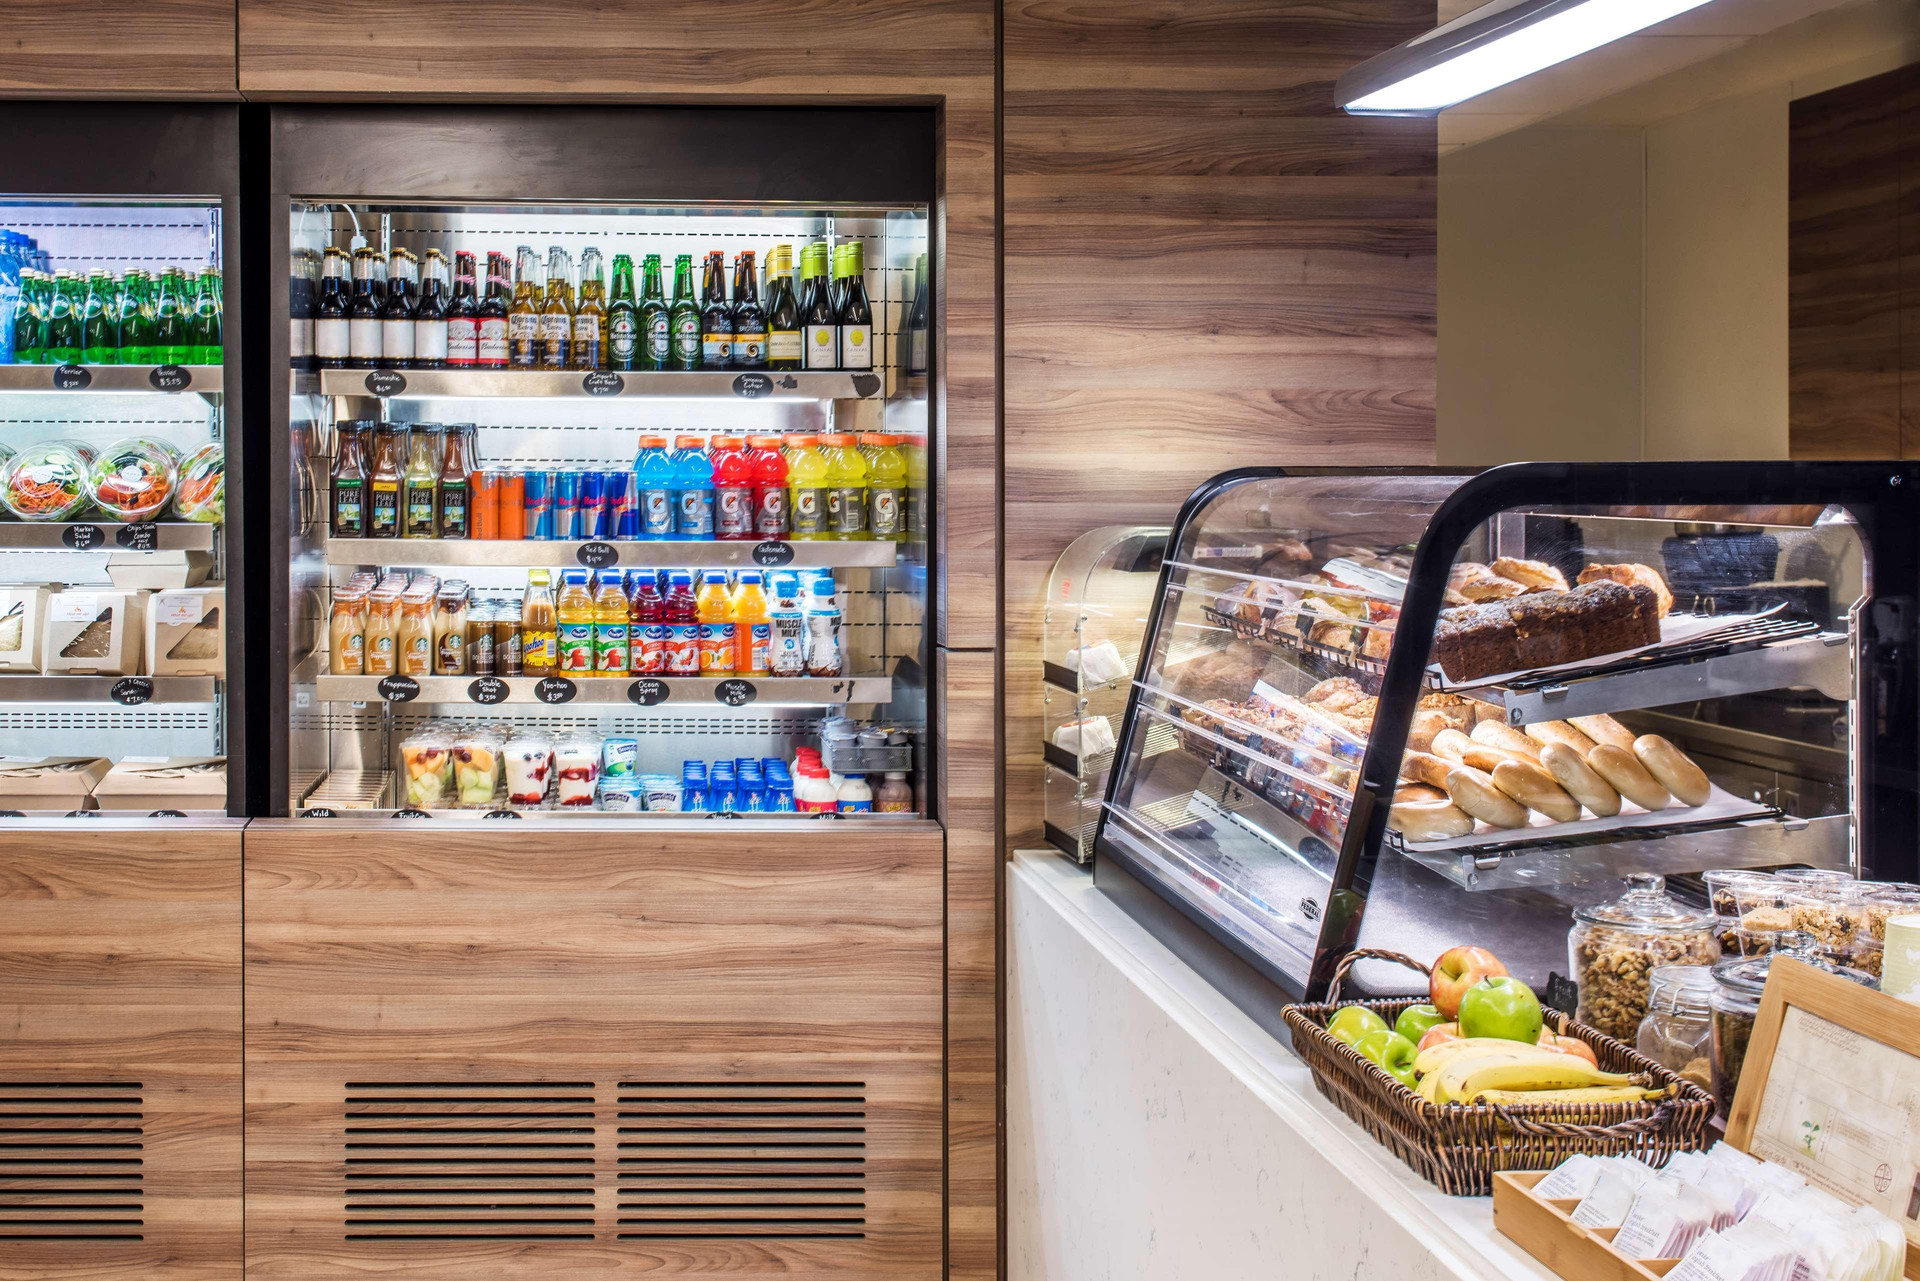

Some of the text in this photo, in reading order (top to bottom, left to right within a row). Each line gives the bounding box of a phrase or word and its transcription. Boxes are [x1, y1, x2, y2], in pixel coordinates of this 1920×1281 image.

[60, 366, 83, 376] Perrier
[584, 496, 599, 504] Red
[648, 492, 665, 514] G
[682, 492, 697, 514] G
[722, 492, 738, 513] G
[764, 492, 781, 513] G
[798, 492, 815, 513] G
[829, 491, 840, 513] G
[875, 492, 893, 514] G
[585, 545, 596, 553] Red
[758, 543, 787, 553] Gatorade
[782, 629, 797, 637] MILK
[543, 681, 568, 692] Yoo-hoo
[640, 687, 658, 695] Spray
[312, 809, 329, 817] Wild
[1300, 902, 1320, 918] FEDERAL
